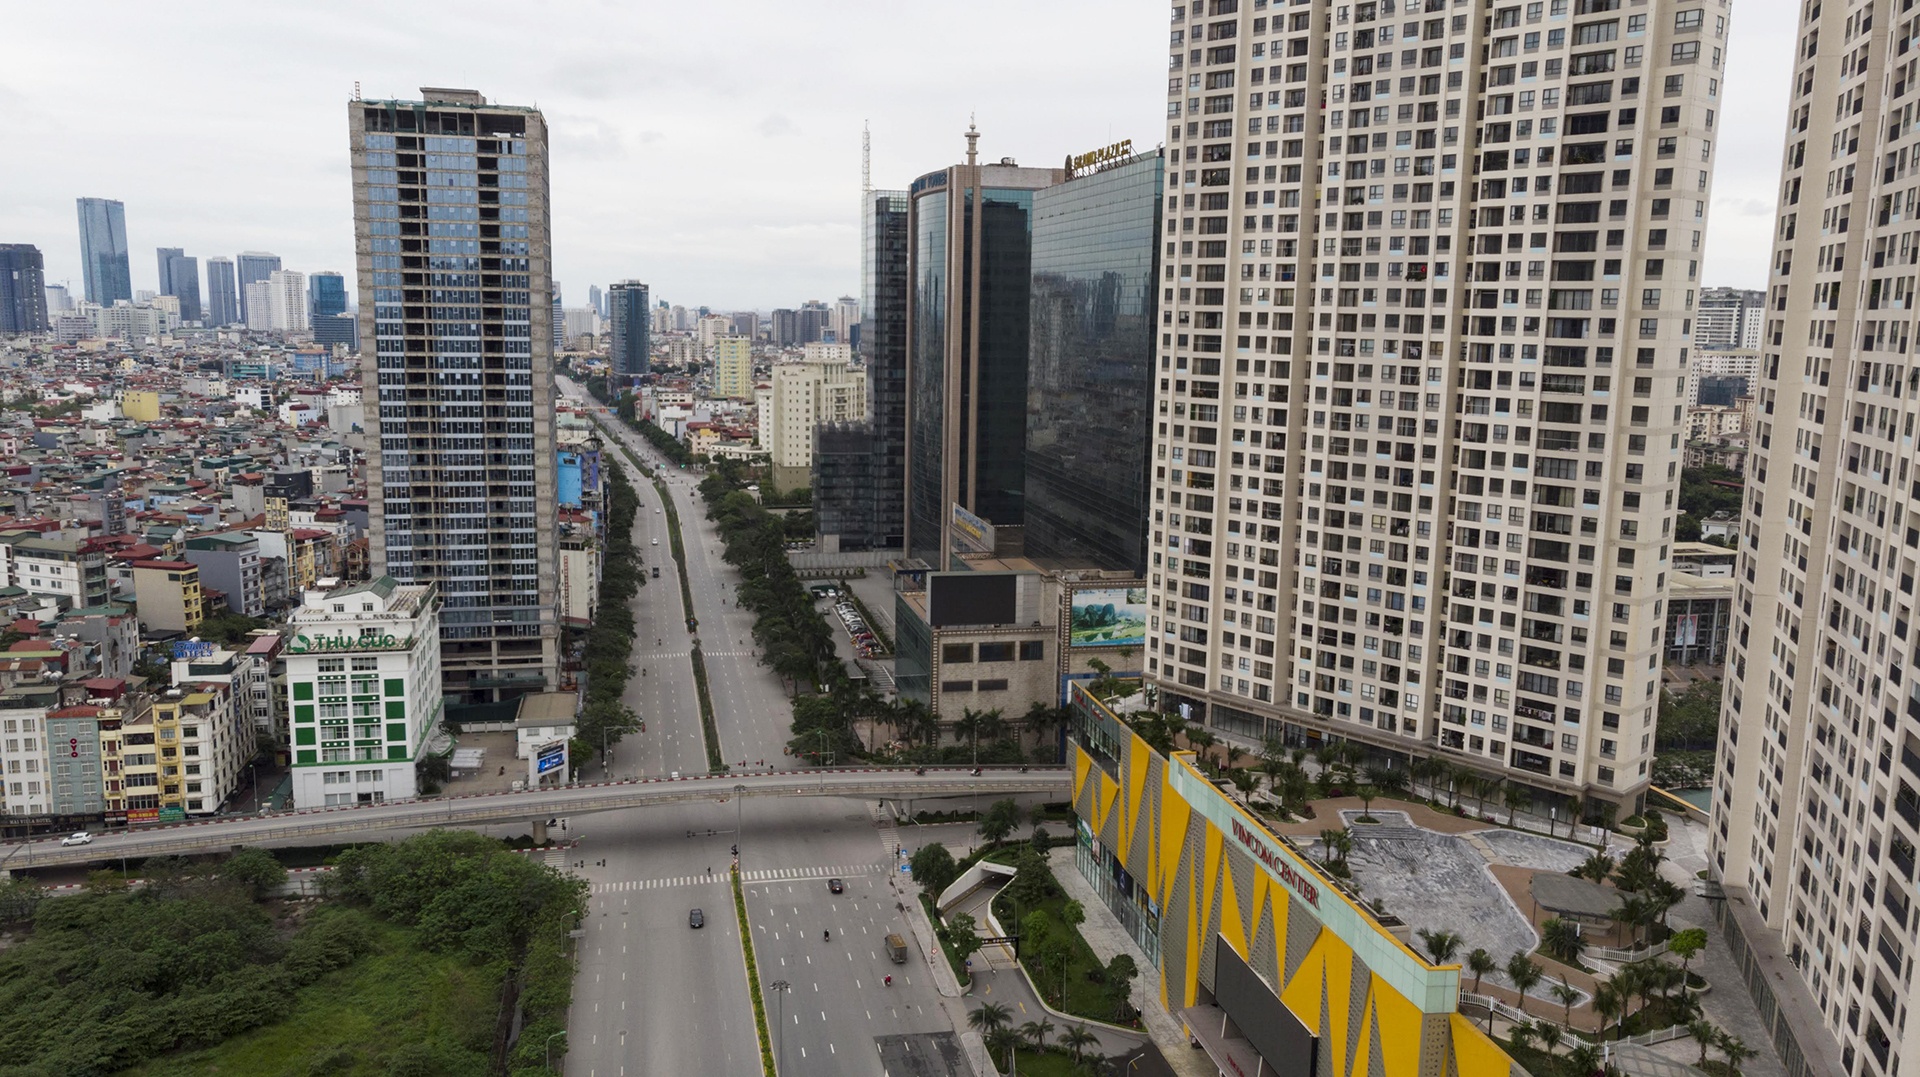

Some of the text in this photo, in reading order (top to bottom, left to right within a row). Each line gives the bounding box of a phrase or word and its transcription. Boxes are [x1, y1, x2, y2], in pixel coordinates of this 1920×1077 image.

[1098, 142, 1120, 160] PLAZA
[315, 636, 353, 650] THU
[69, 738, 78, 758] OYO
[1231, 817, 1319, 909] VINCOM CENTER
